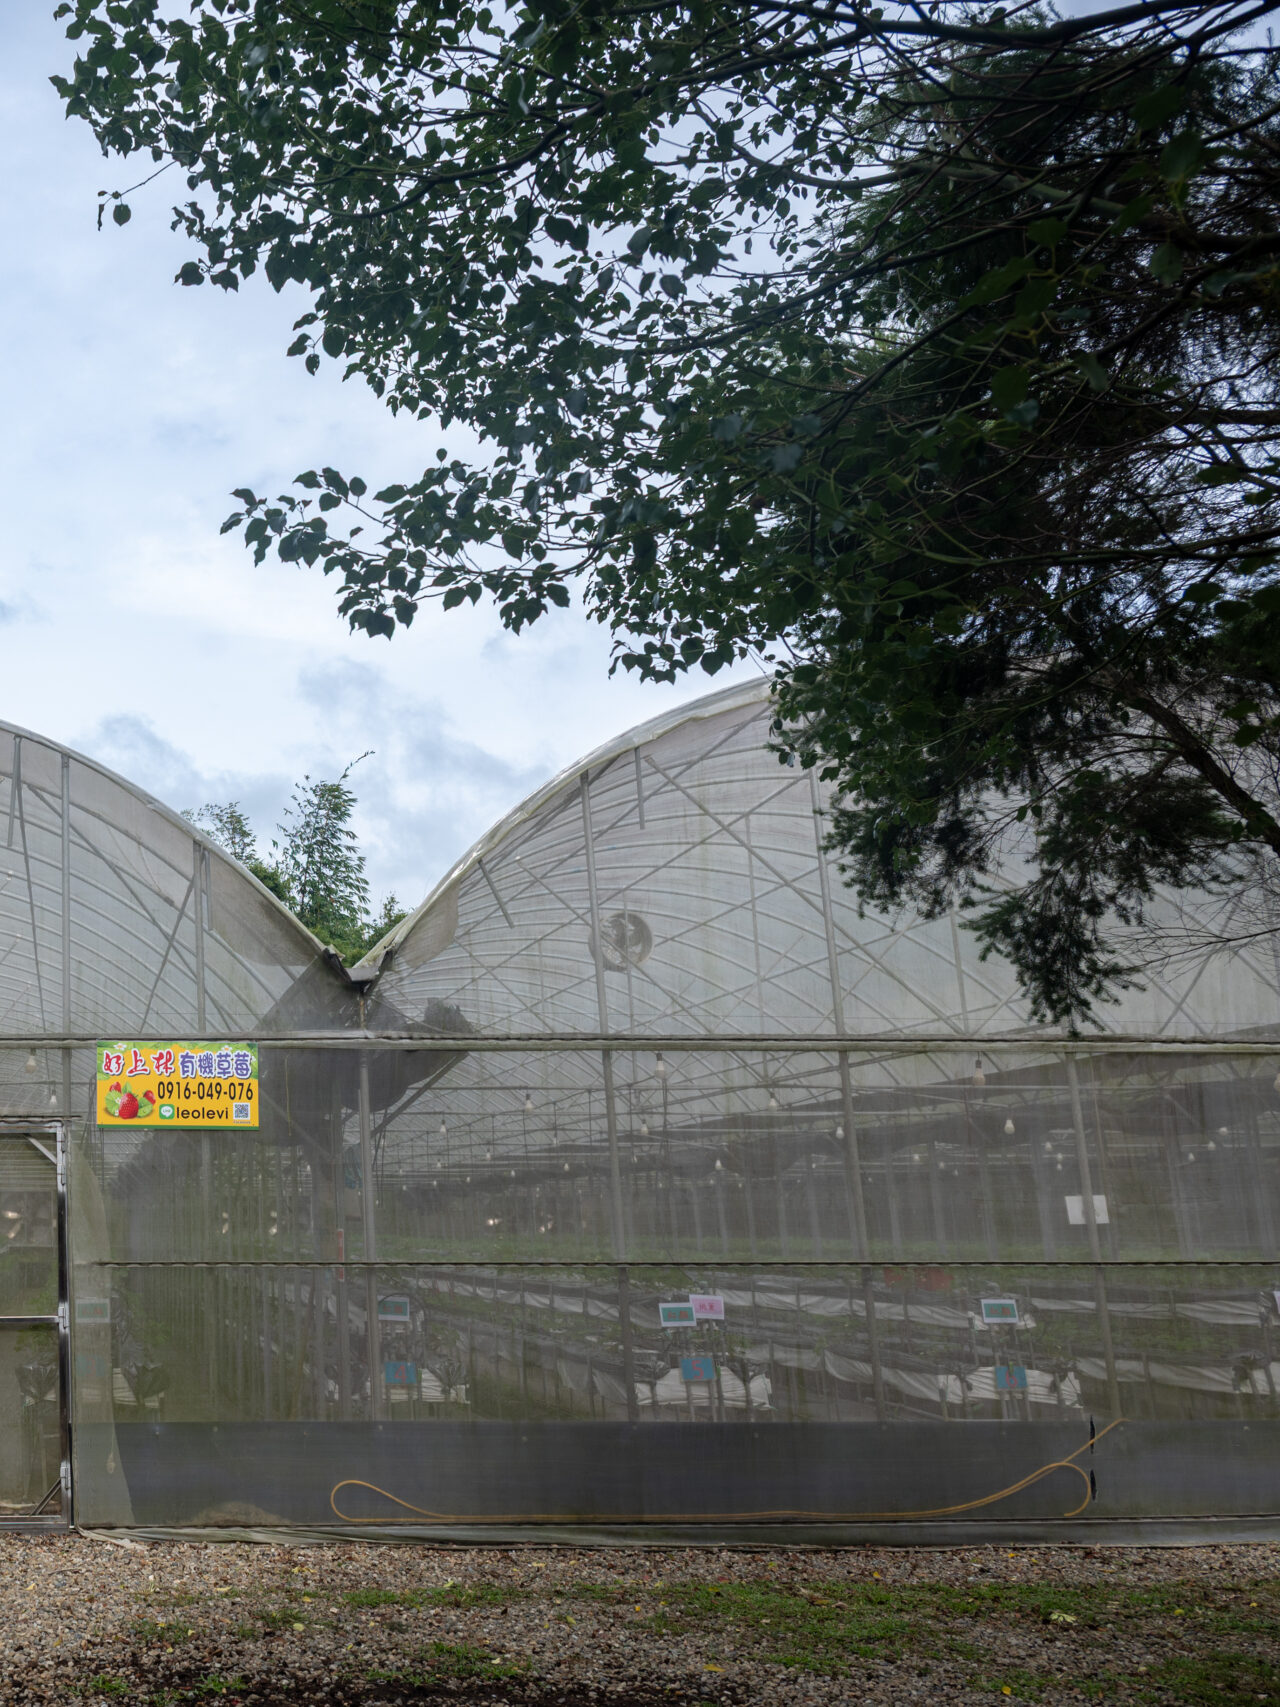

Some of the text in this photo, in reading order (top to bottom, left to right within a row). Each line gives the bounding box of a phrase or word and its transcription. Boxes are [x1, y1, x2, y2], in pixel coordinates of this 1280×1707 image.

[179, 1051, 251, 1077] 有機草莓
[157, 1081, 254, 1101] 0916-049-076
[176, 1106, 229, 1119] leolevi
[394, 1364, 408, 1383] 4
[691, 1359, 705, 1379] 5
[1005, 1368, 1018, 1389] 6
